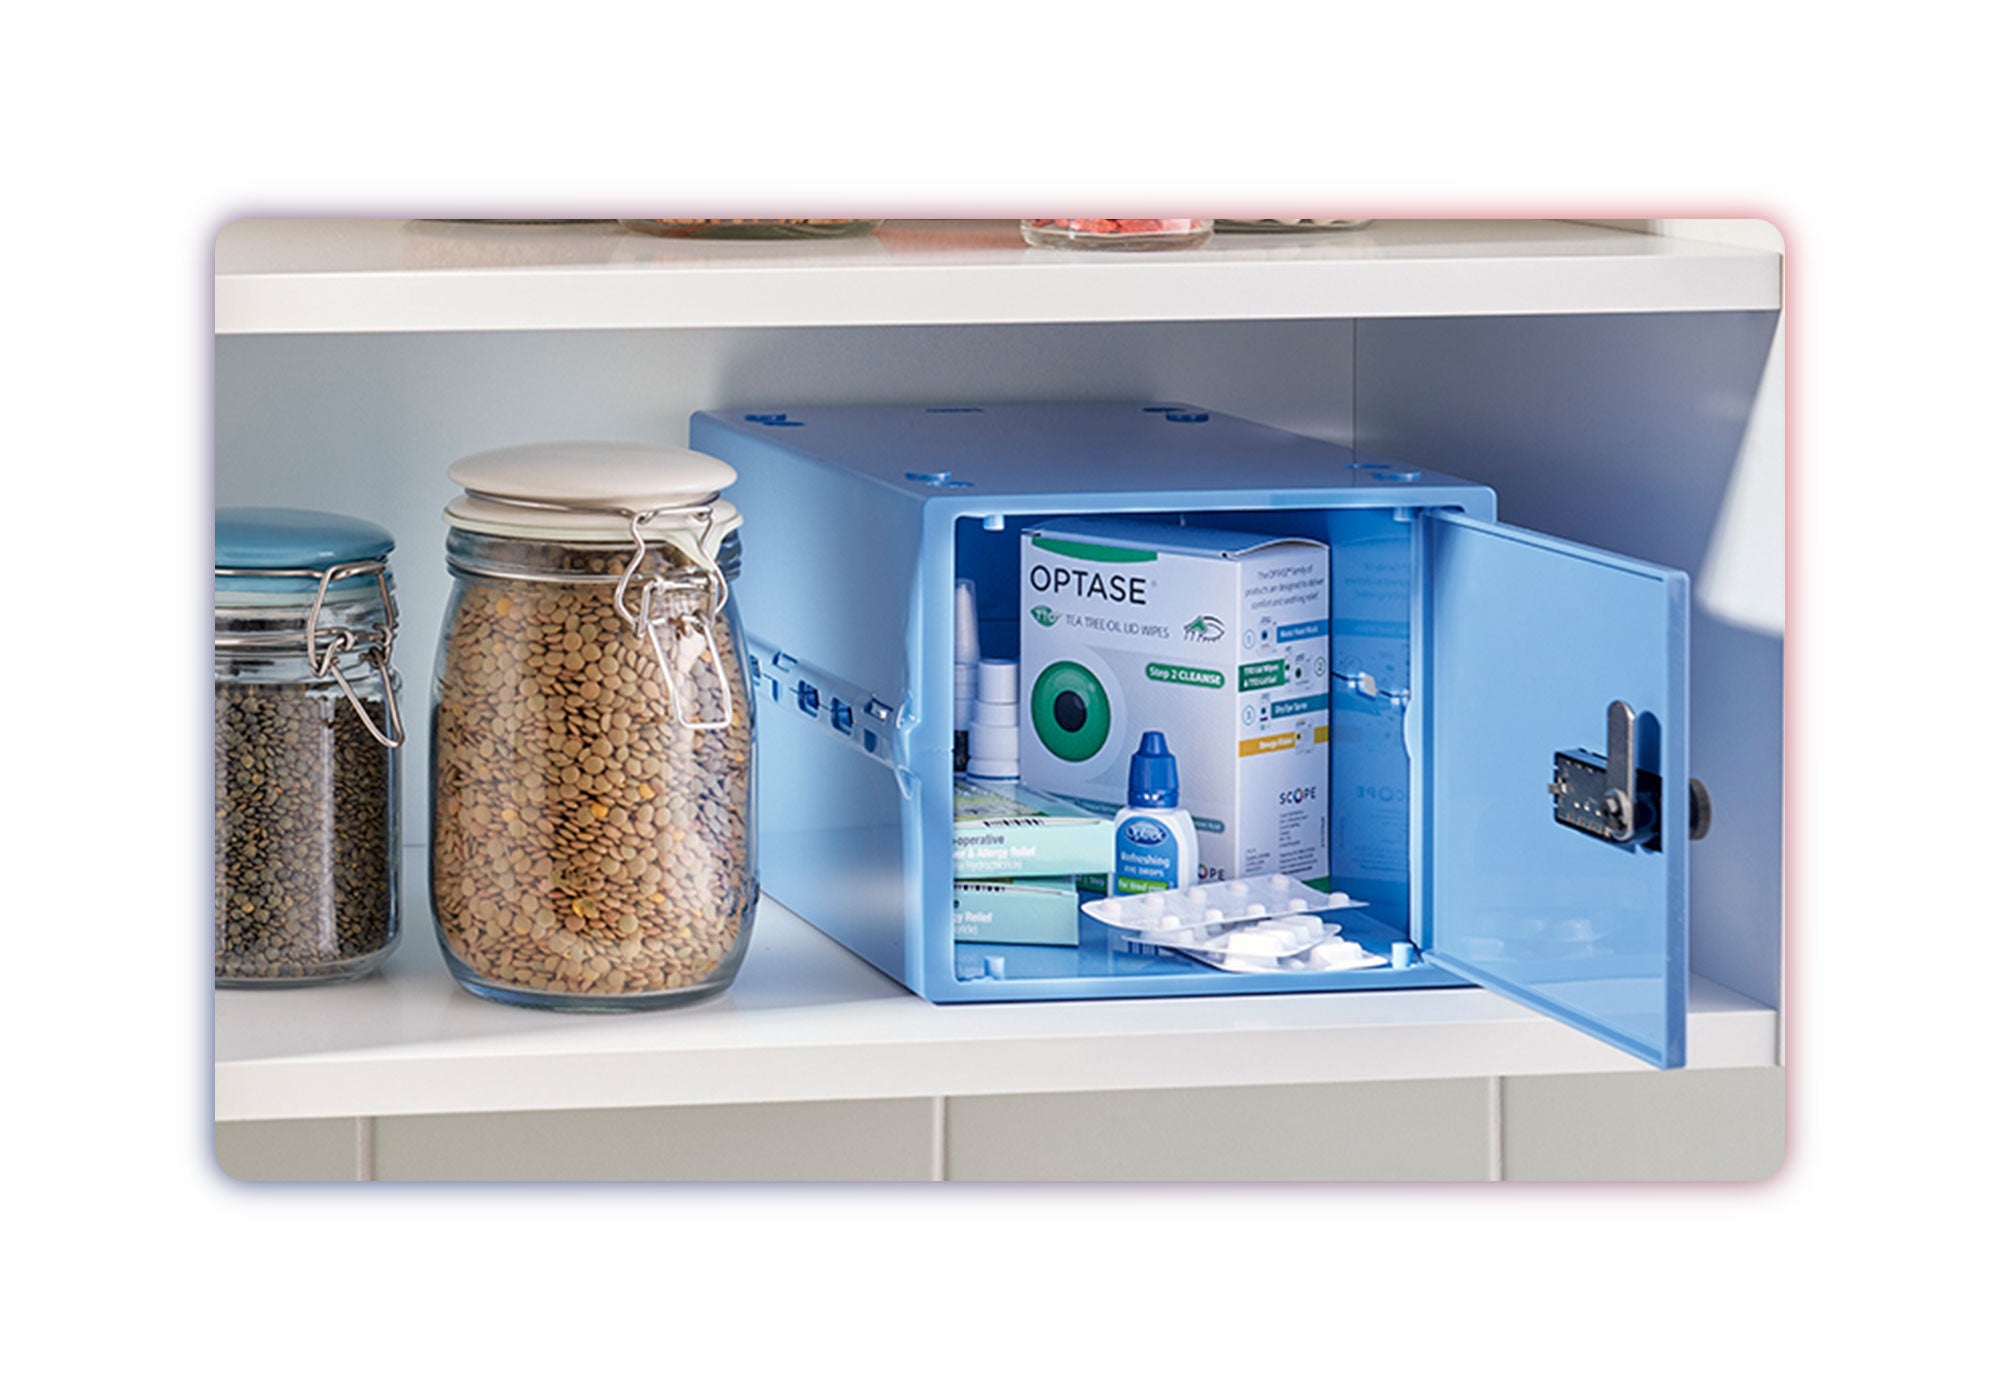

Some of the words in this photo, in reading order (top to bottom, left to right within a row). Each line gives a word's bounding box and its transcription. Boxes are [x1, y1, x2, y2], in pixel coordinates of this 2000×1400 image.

[1030, 565, 1146, 605] OPTASE
[1066, 614, 1083, 627] TEA
[1085, 616, 1104, 630] TREE
[1106, 619, 1122, 632] OIL
[1124, 621, 1139, 635] LID
[1141, 624, 1170, 639] WIPES
[1149, 664, 1169, 680] Step
[1171, 668, 1178, 680] 2
[1178, 669, 1222, 686] CLEANSE
[1279, 786, 1316, 805] SCOPE
[1010, 844, 1037, 858] Relief
[1121, 851, 1170, 869] Refreshing
